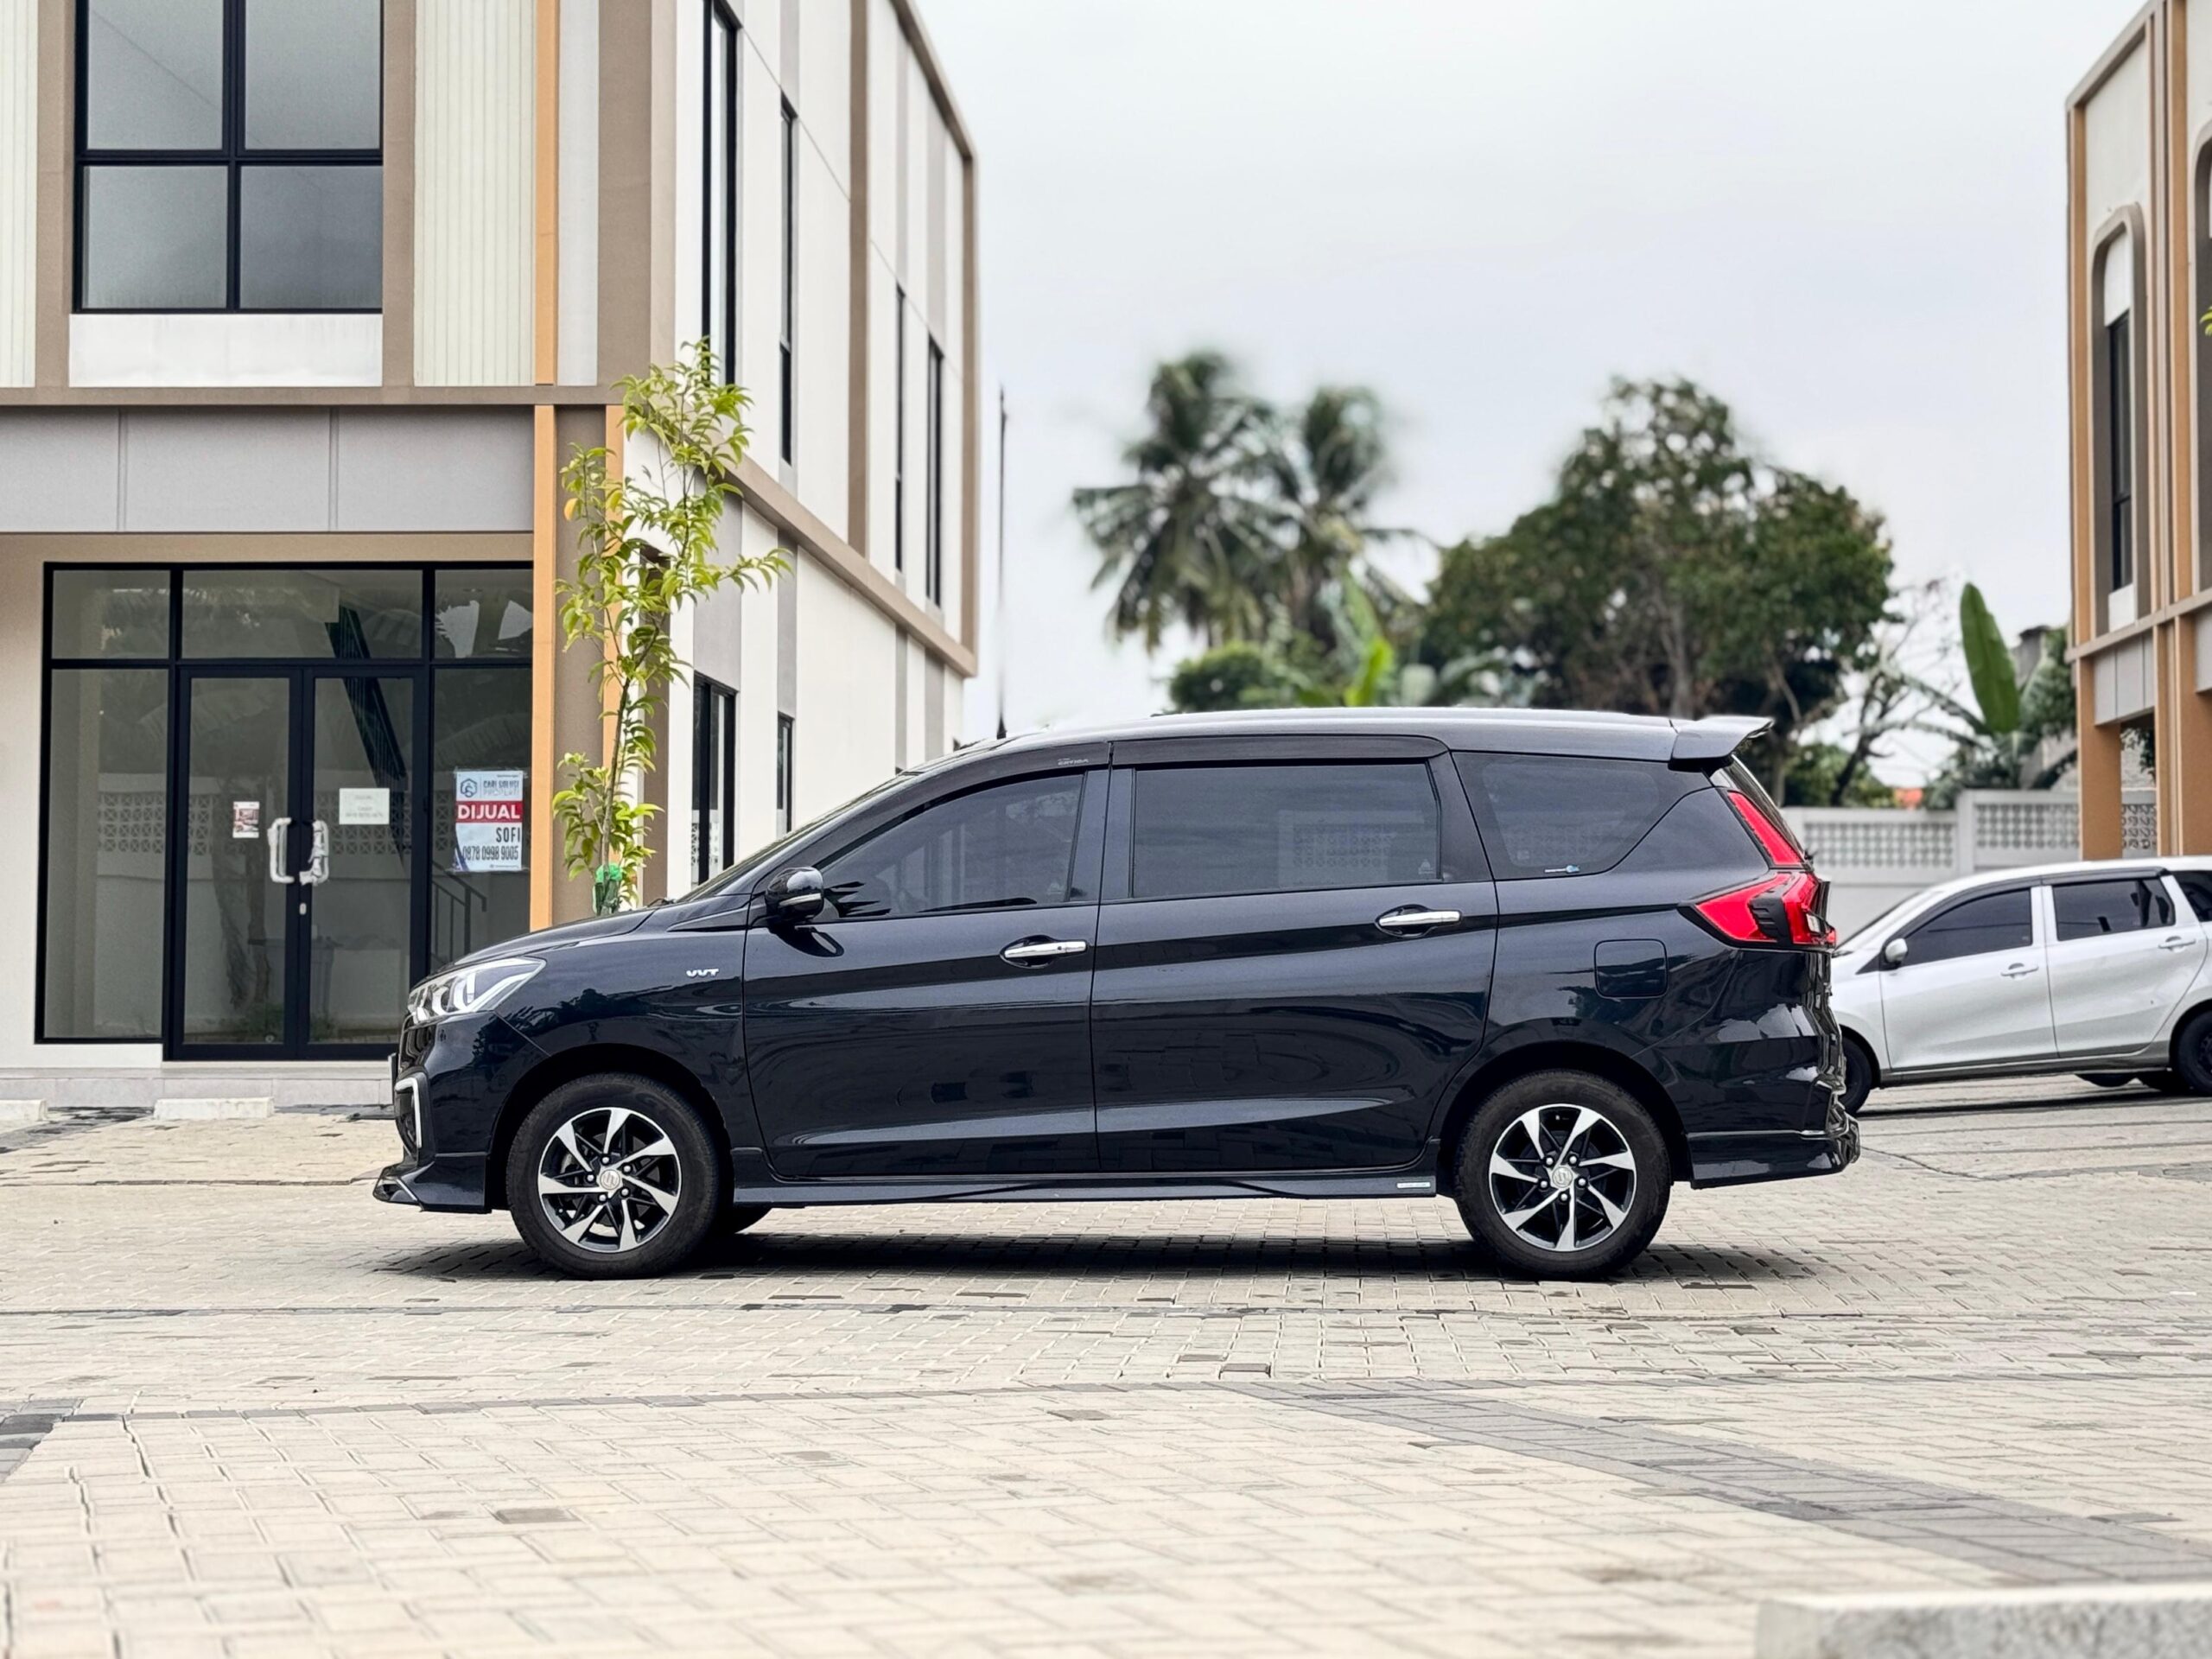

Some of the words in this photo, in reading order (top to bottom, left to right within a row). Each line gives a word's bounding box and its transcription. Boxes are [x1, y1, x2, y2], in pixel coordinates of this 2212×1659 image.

[457, 804, 520, 819] DIJUAL
[496, 827, 520, 842] SOFI
[462, 846, 480, 861] 0878
[500, 846, 518, 861] 9005
[686, 968, 719, 977] VVT
